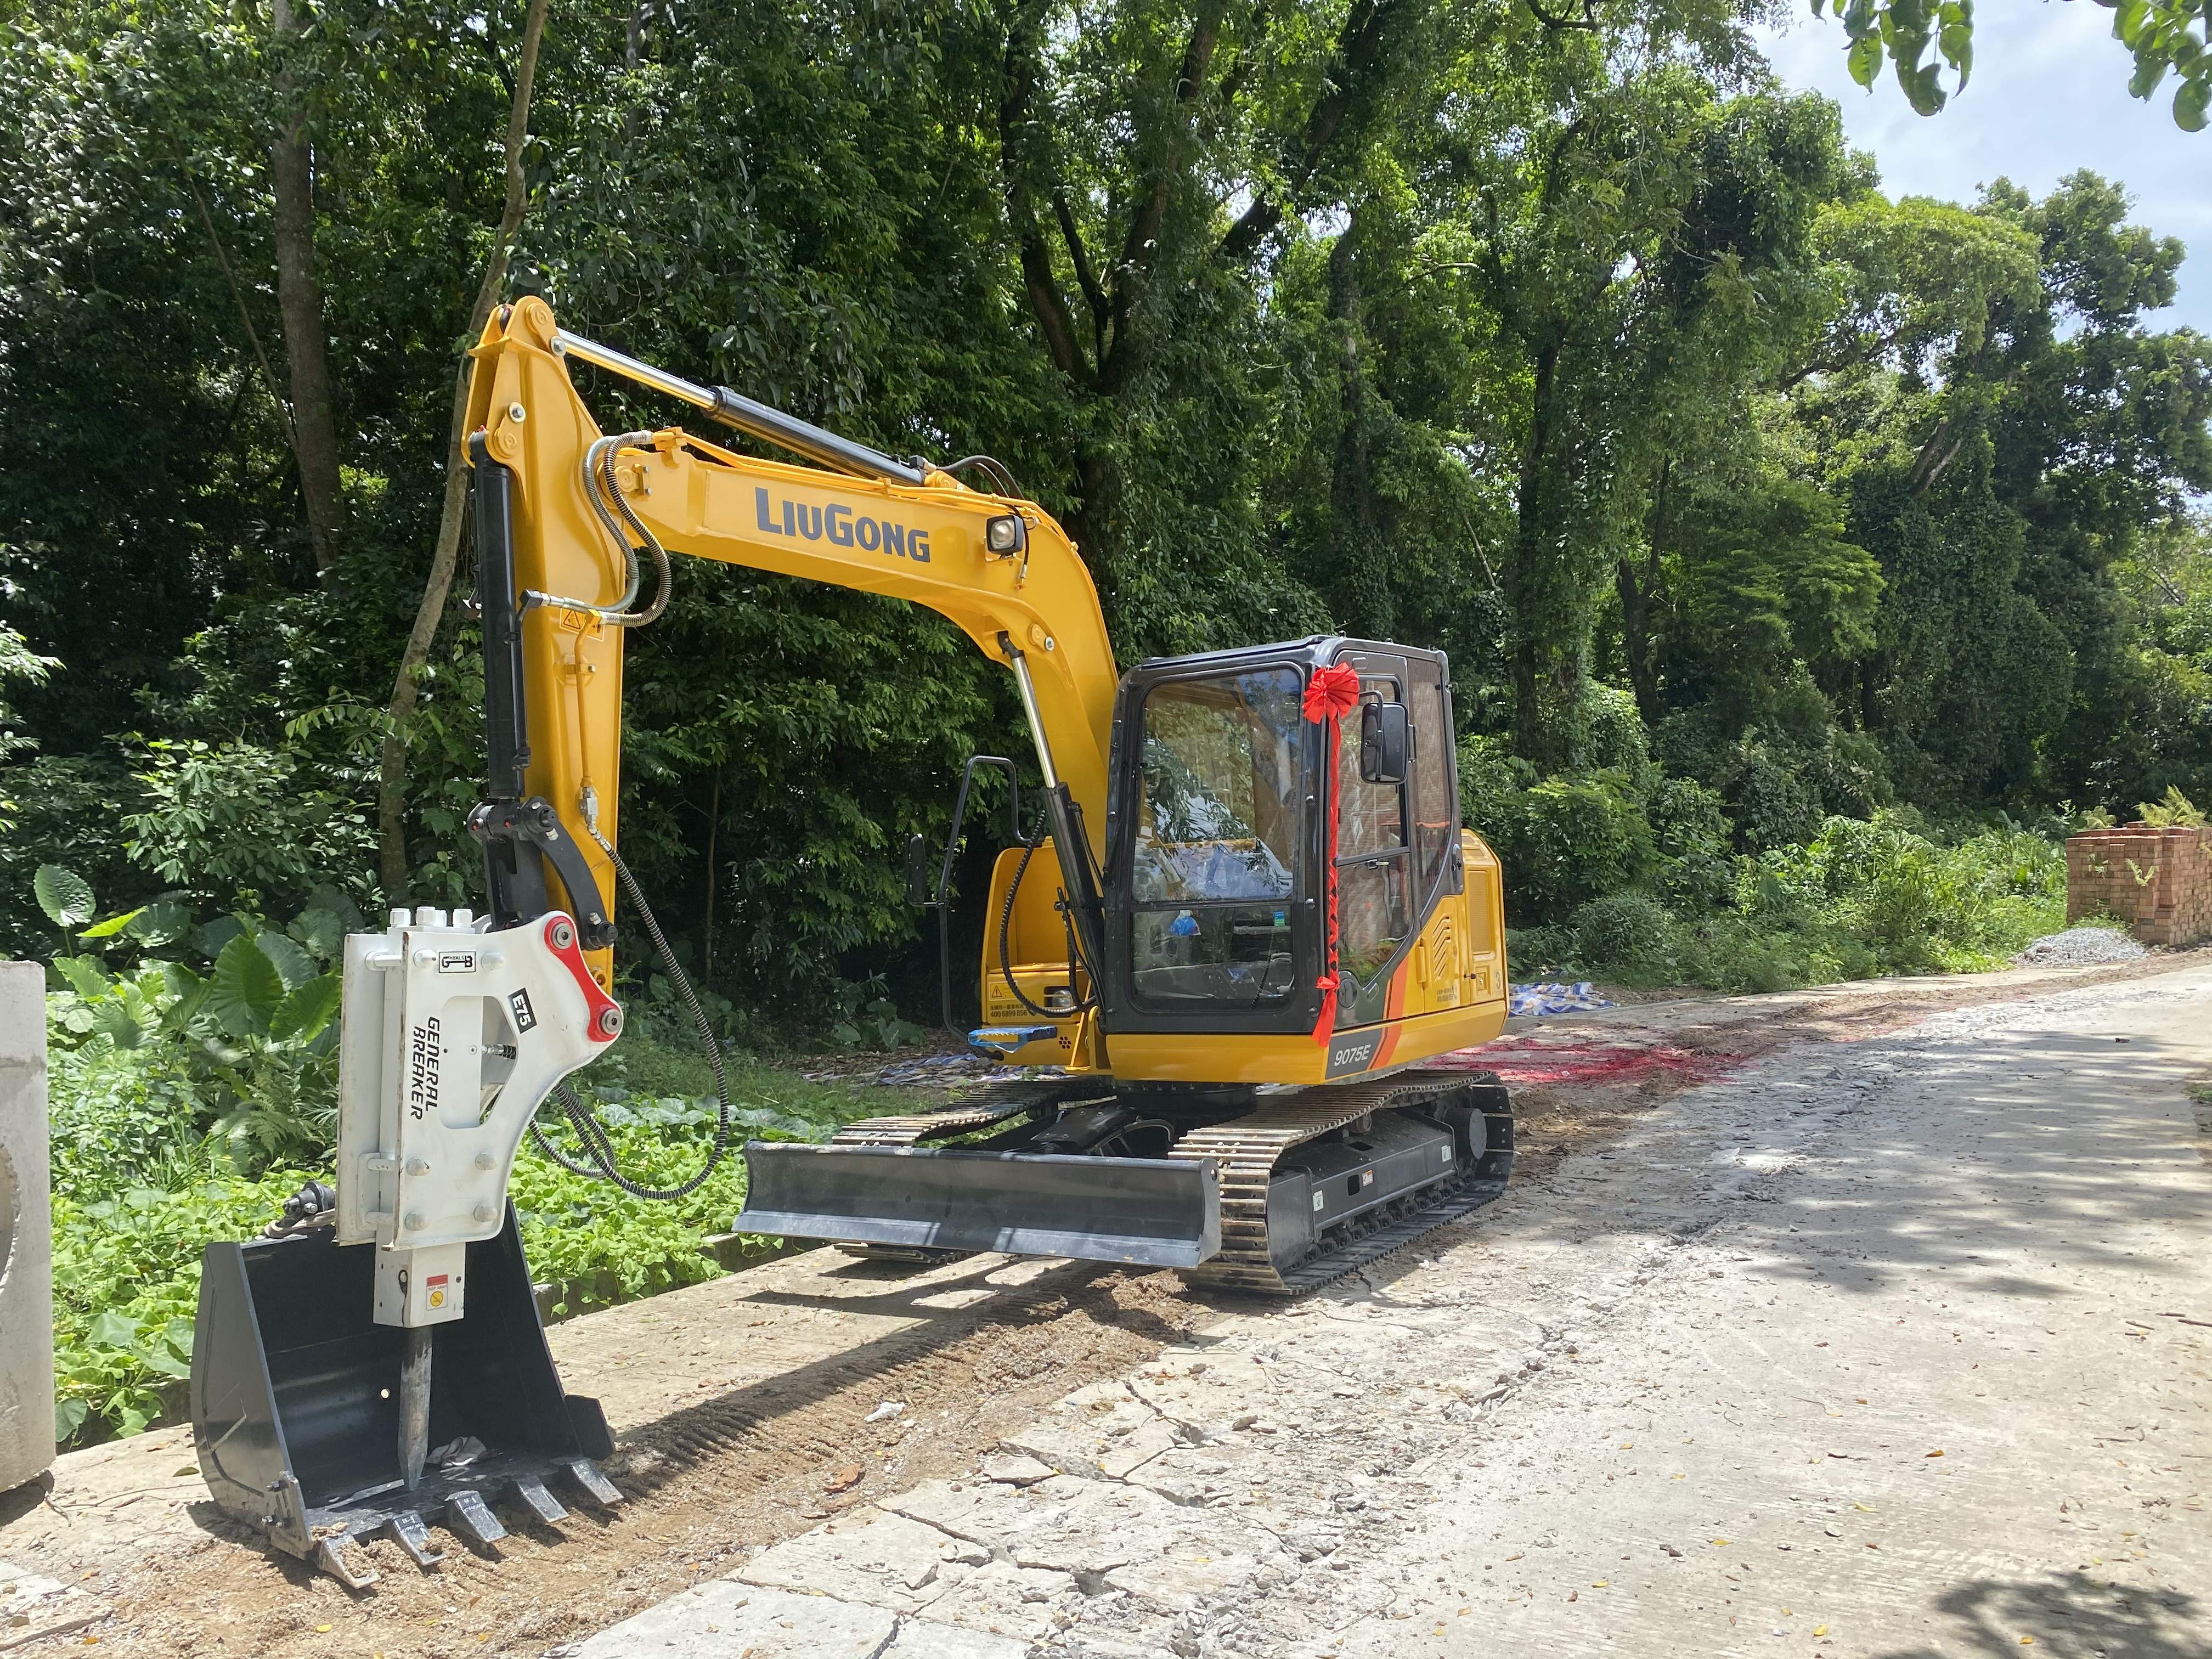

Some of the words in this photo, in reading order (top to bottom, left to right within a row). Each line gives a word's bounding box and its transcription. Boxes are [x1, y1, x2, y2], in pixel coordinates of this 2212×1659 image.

[1496, 971, 1502, 990] 3
[512, 994, 532, 1026] E75
[425, 1016, 440, 1112] GENERAL
[1334, 1044, 1372, 1066] 9075E
[410, 1025, 426, 1120] BREAKER
